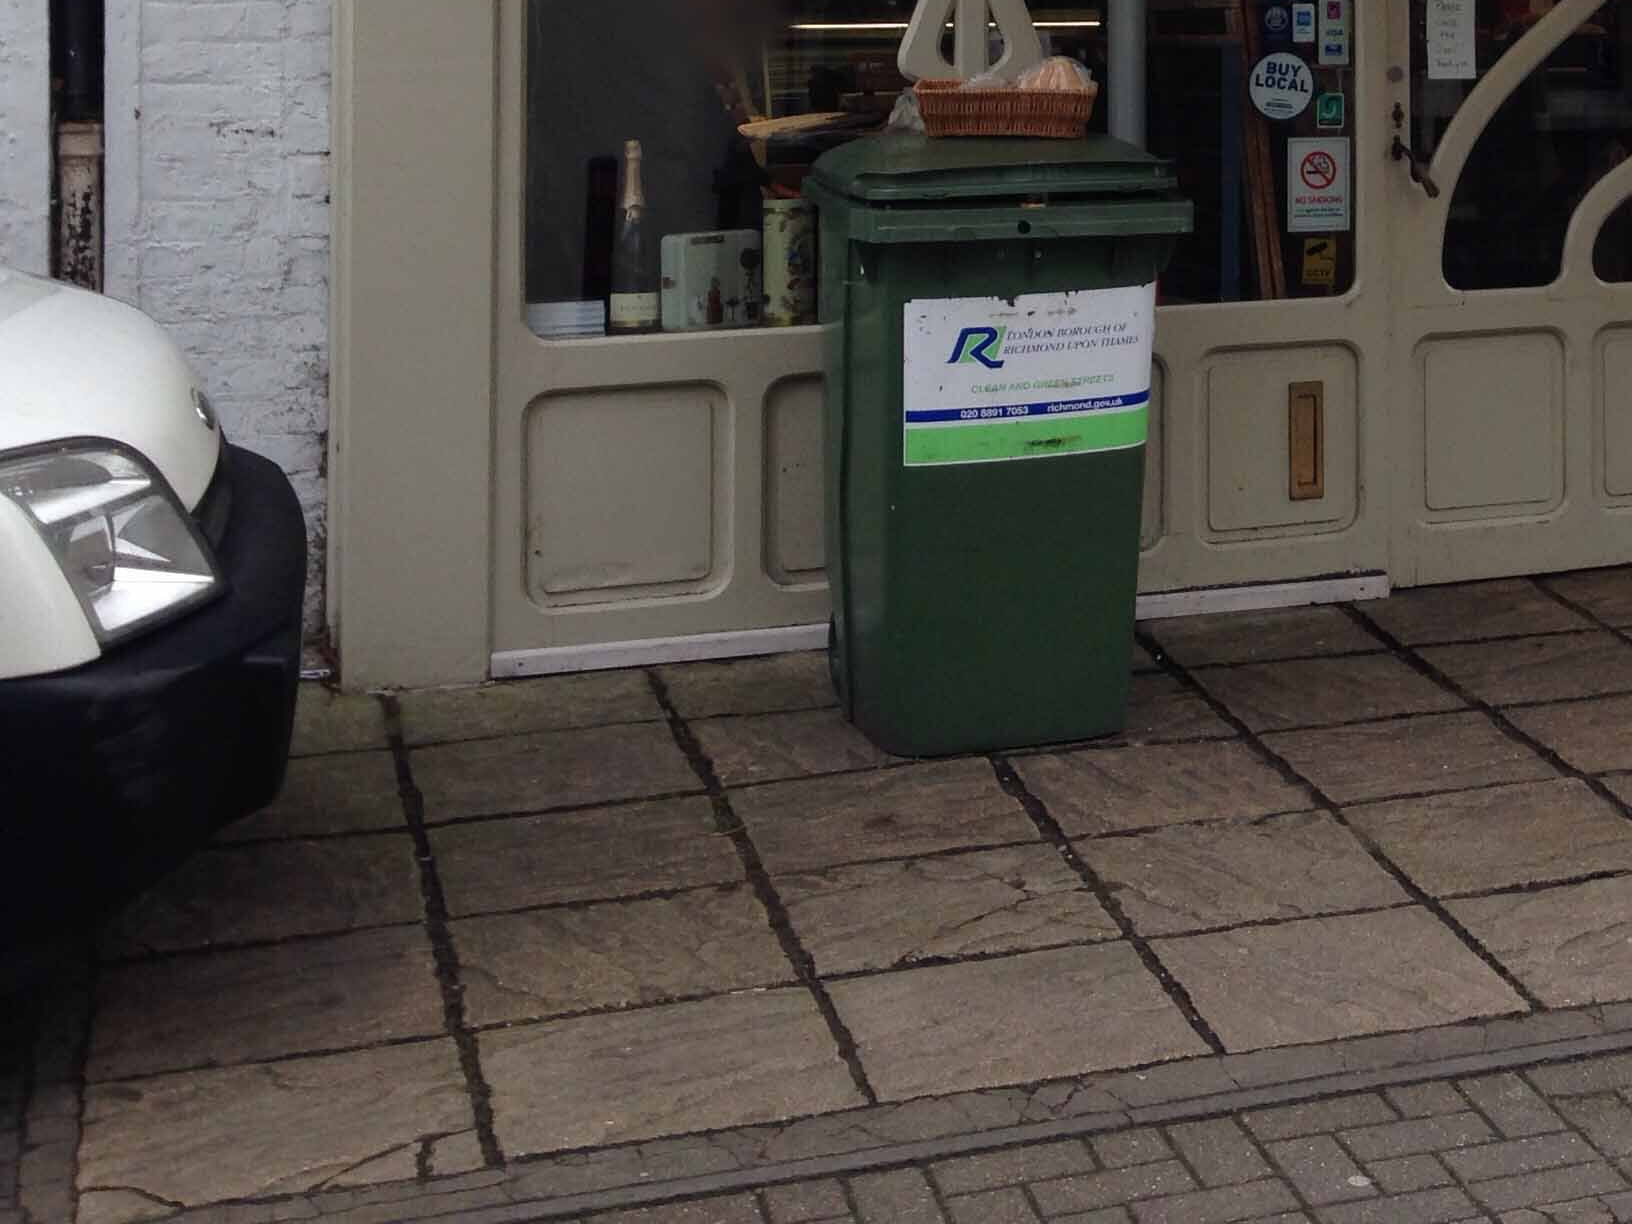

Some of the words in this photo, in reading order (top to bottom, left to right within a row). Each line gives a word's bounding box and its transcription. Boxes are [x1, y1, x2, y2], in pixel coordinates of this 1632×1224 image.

[1266, 62, 1301, 77] BUY
[1255, 73, 1309, 93] LOCAL
[1006, 329, 1054, 342] LONDON
[1057, 325, 1111, 338] BOROUGH
[1003, 342, 1065, 355] RICHMOND
[1067, 339, 1098, 352] UPON
[1100, 336, 1139, 348] THAMES
[971, 383, 1004, 394] CLEAN
[1006, 382, 1031, 392] AND
[1033, 379, 1071, 390] GREEN
[1072, 374, 1115, 388] STREETS
[960, 408, 978, 419] 020
